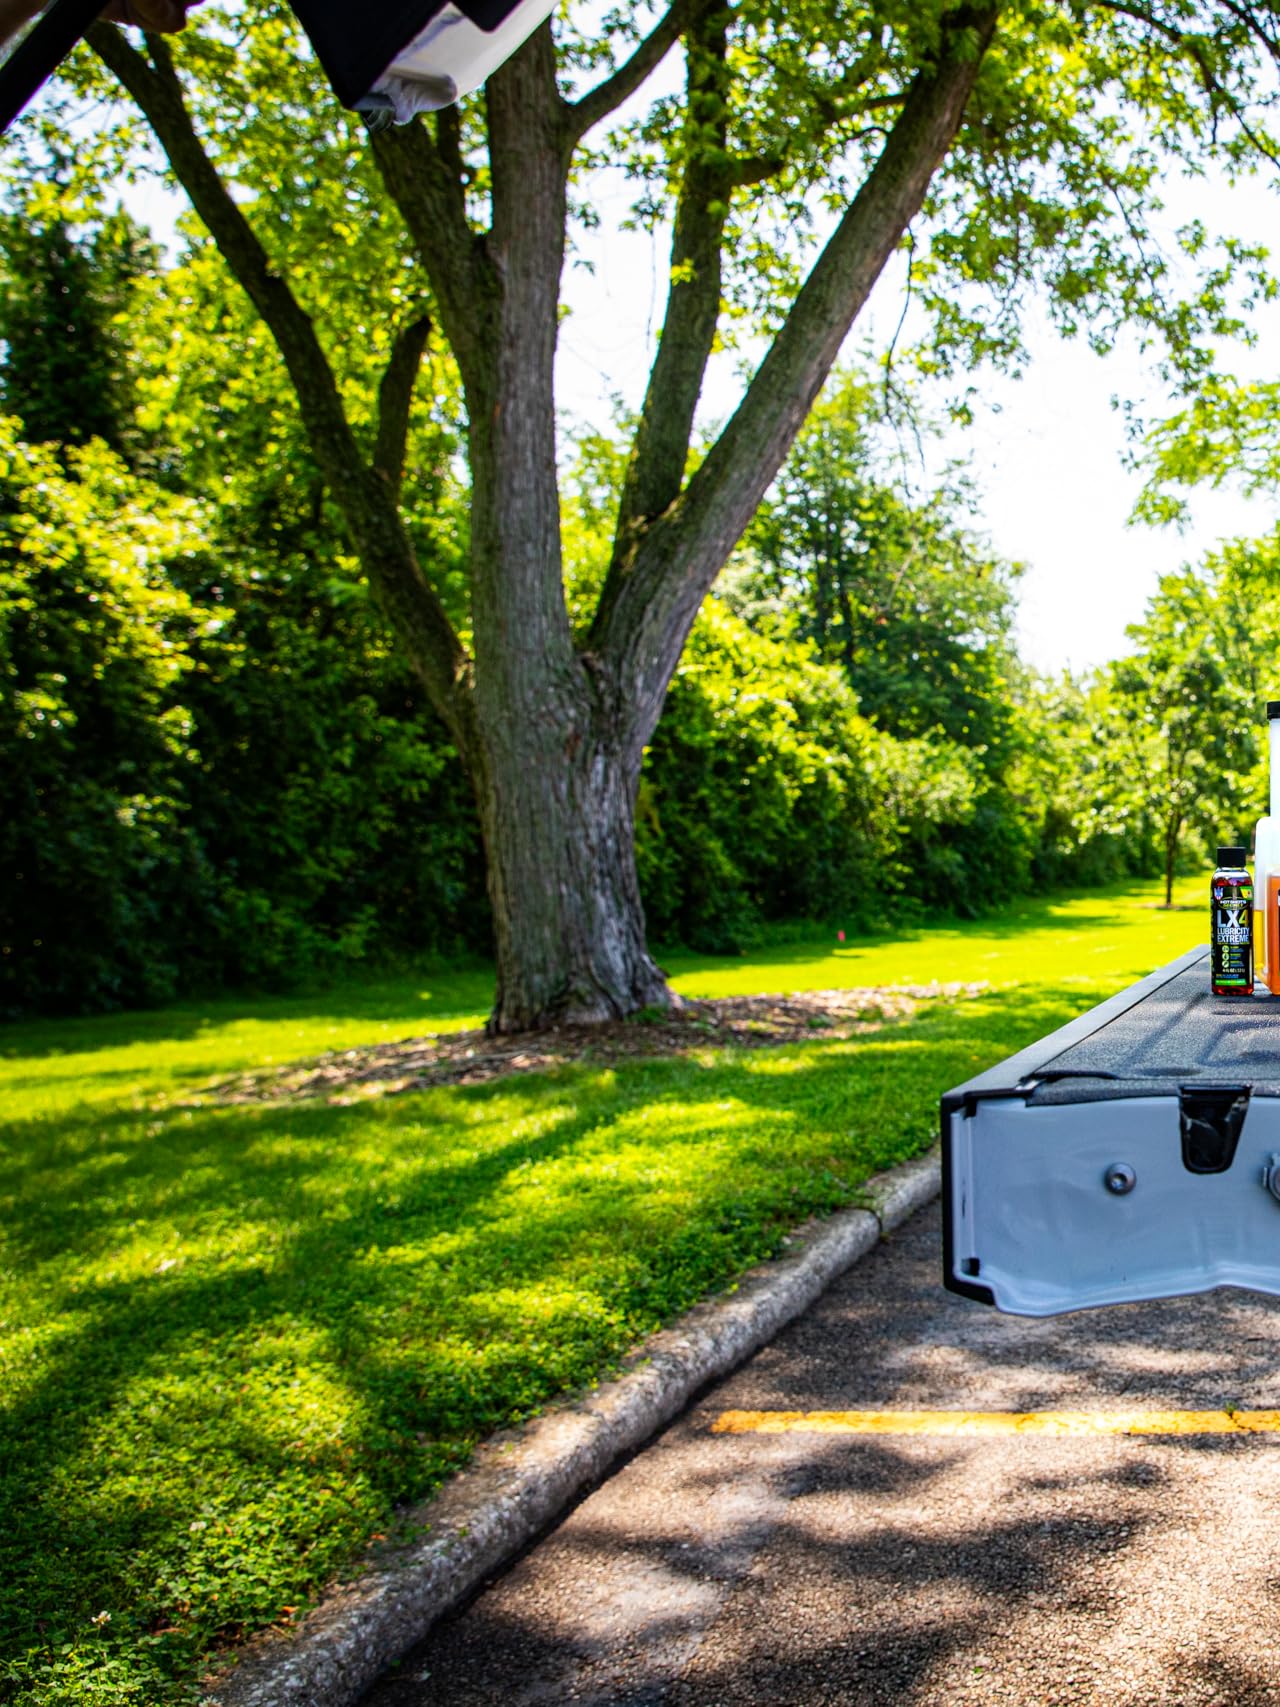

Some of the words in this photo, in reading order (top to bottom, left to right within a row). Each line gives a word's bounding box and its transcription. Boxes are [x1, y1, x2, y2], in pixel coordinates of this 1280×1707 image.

[1217, 909, 1248, 927] LX4
[1217, 927, 1249, 935] LUBRICITY
[1217, 934, 1249, 942] EXTREME
